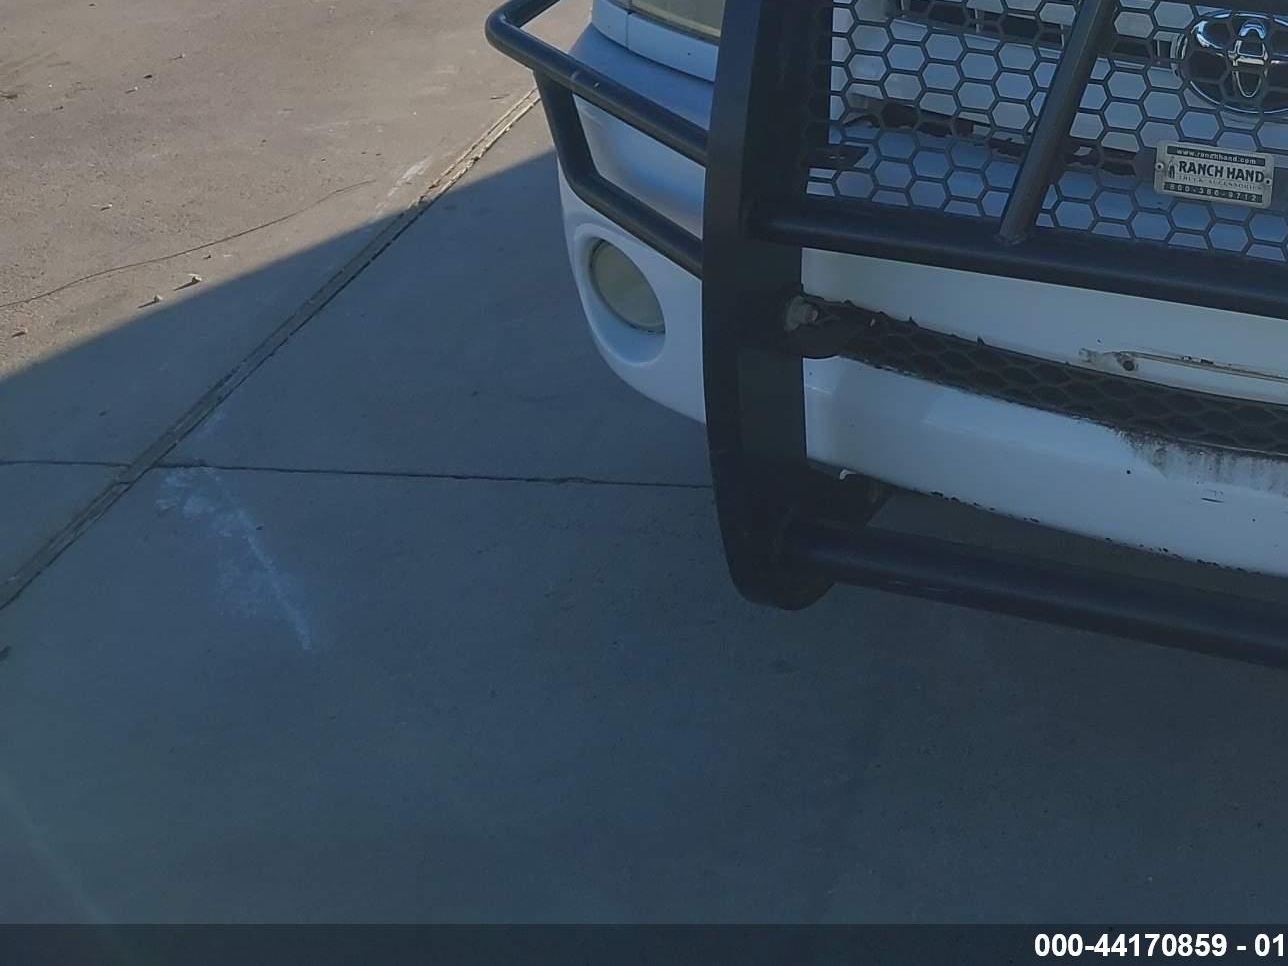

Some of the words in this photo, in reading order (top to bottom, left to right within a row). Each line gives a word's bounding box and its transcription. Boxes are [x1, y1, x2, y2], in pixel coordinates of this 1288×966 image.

[1176, 148, 1257, 165] www.ranchhand.com
[1179, 160, 1224, 178] RANCH
[1226, 167, 1265, 183] HAND
